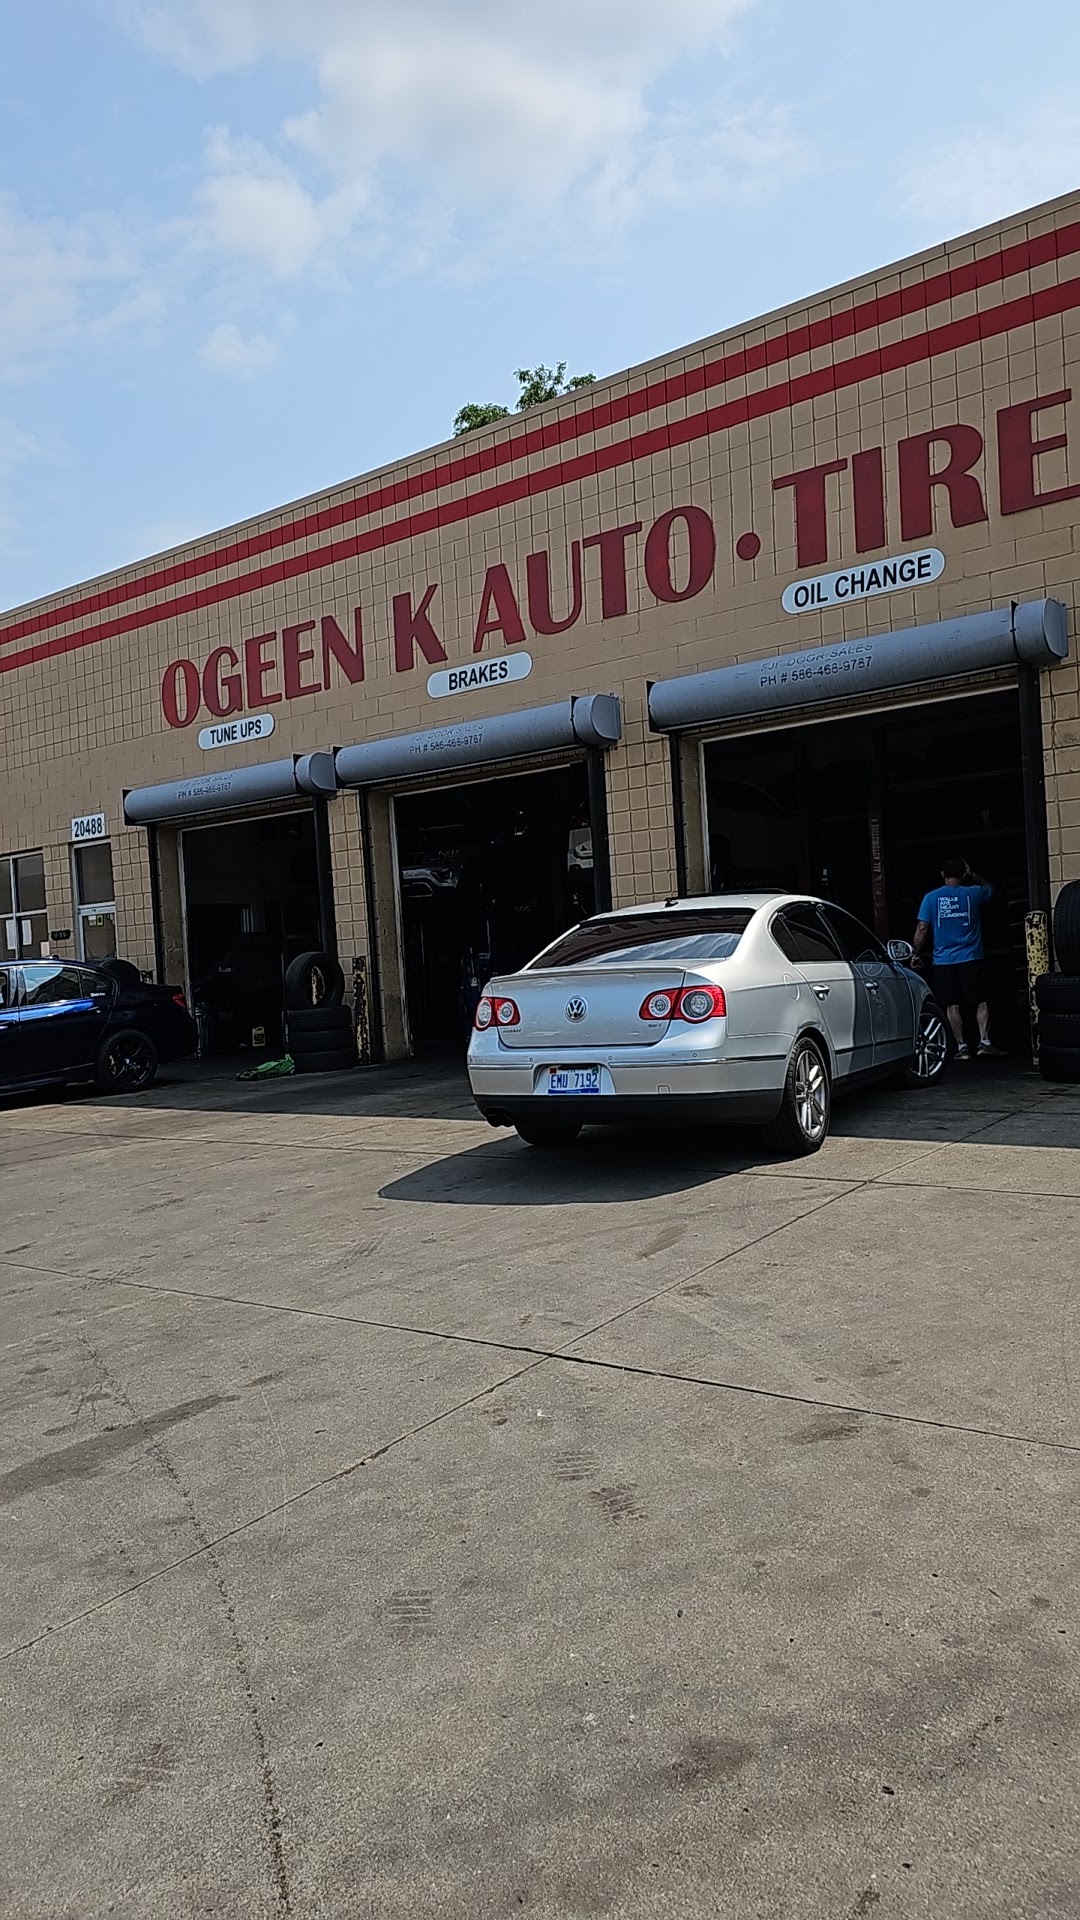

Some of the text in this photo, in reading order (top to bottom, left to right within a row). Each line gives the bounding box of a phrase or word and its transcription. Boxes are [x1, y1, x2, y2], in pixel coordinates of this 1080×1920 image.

[161, 388, 1080, 728] OGEEN K AUTO TIRE
[794, 554, 932, 608] OIL CHANGE
[786, 655, 824, 667] DOOR
[829, 643, 874, 657] SALES
[448, 660, 509, 691] BRAKES
[759, 656, 873, 687] PH # 586-468-9787
[209, 719, 262, 745] TUNE UPS
[409, 745, 422, 755] PH
[423, 742, 429, 752] #
[74, 817, 103, 838] 20488
[550, 1073, 598, 1089] EMU 7192
